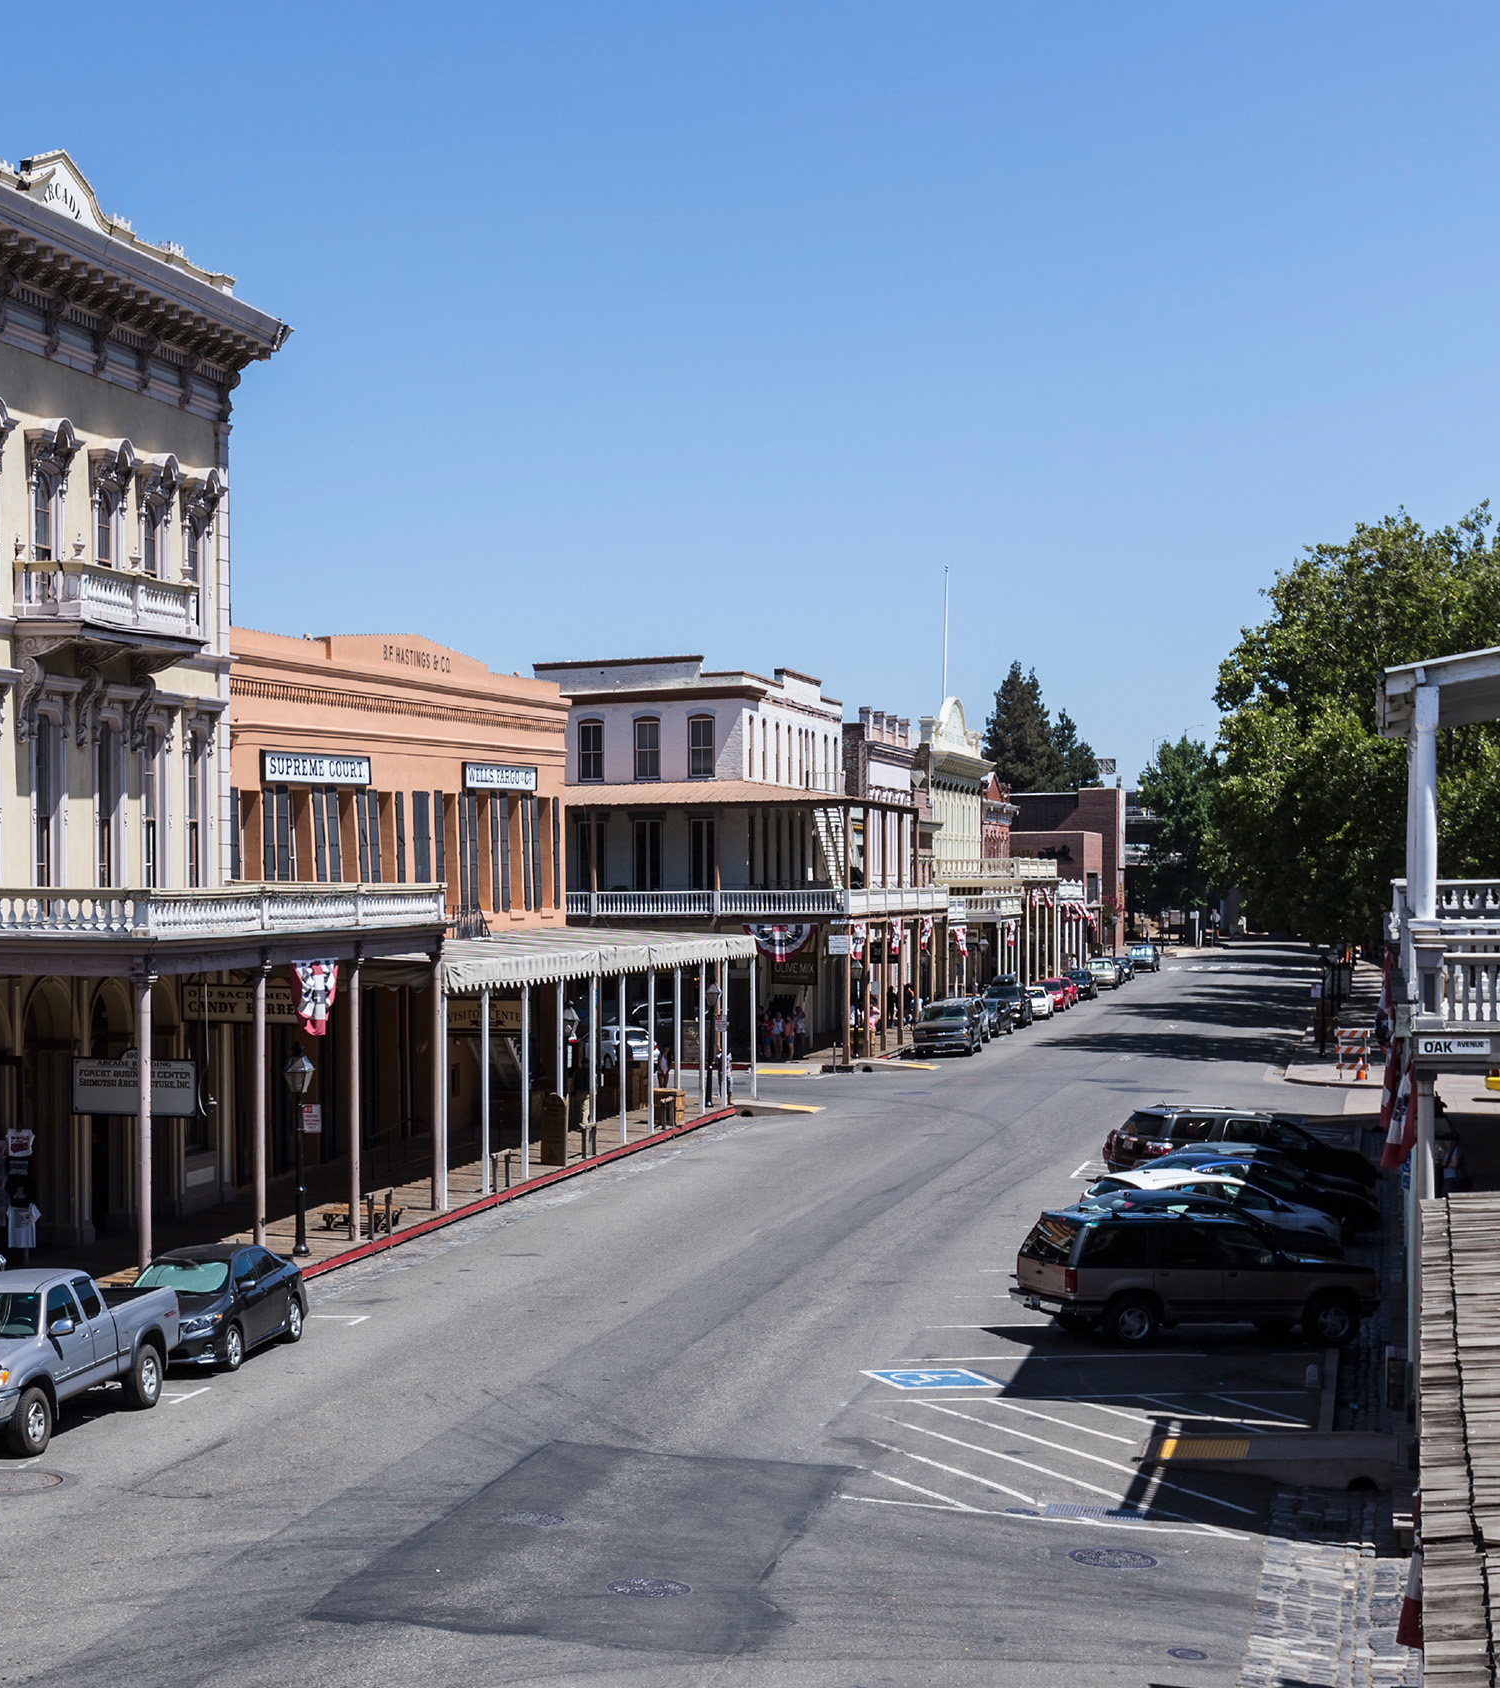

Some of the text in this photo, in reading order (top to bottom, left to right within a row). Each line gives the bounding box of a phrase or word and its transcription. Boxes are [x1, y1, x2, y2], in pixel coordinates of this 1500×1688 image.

[395, 646, 431, 669] HASTINGS
[433, 654, 439, 671] &
[441, 656, 452, 673] CO.
[269, 756, 325, 777] SUPREME
[496, 768, 520, 785] FARGO
[774, 962, 815, 974] OLIVE MIX
[217, 990, 291, 1000] SACRMEN
[187, 1001, 297, 1015] CANDY BRRE
[447, 1008, 522, 1024] VISITO CENTE
[1424, 1041, 1453, 1053] OAK
[132, 1060, 172, 1068] BDING
[79, 1069, 191, 1079] FOREST BUSINS CENTER
[79, 1078, 117, 1087] SHIMOTSU
